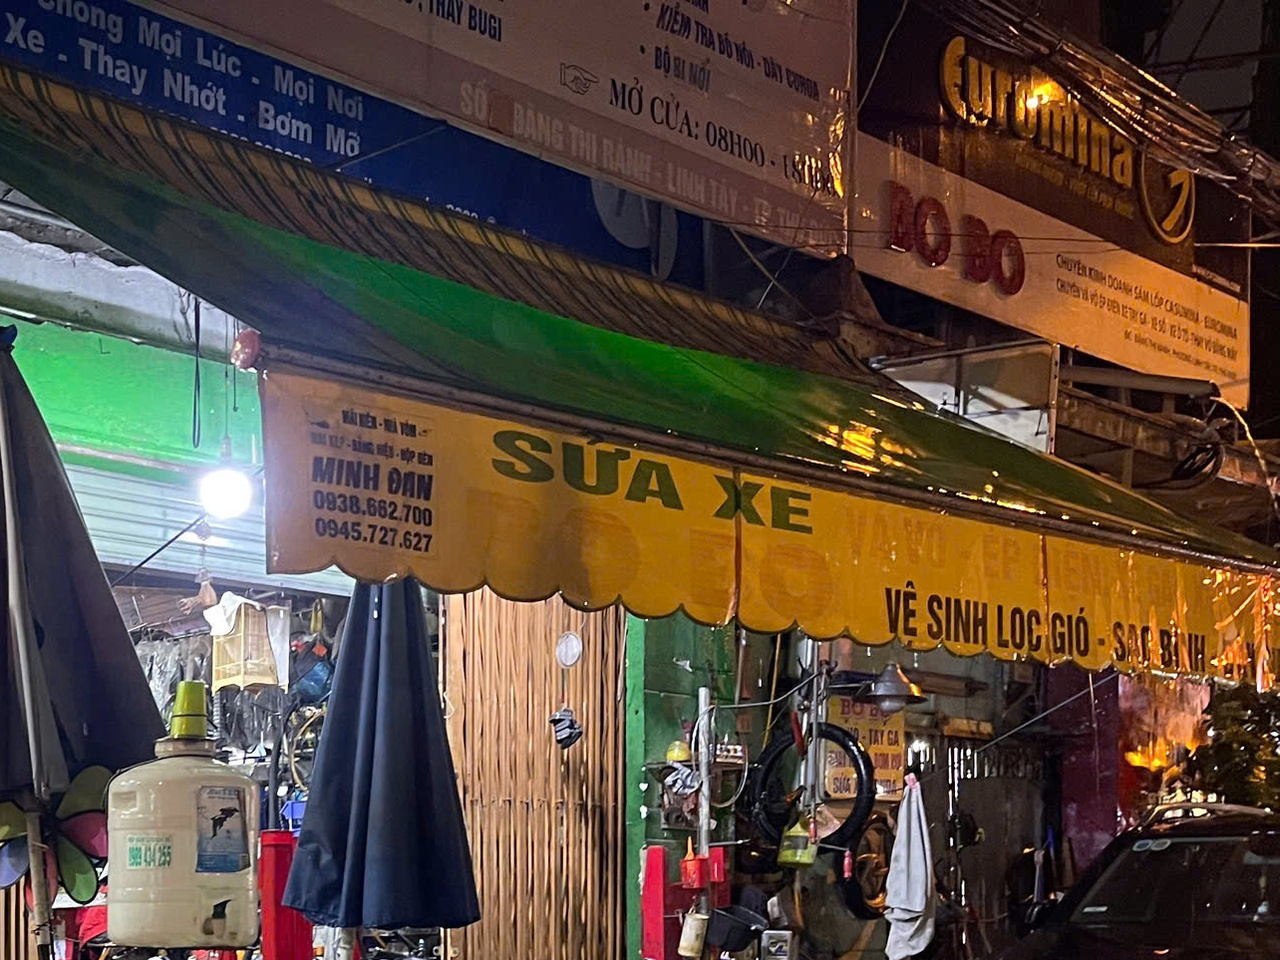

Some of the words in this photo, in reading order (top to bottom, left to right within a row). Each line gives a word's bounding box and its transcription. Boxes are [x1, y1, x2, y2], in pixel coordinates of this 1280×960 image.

[468, 4, 503, 42] BUGI
[4, 12, 46, 54] Xe
[78, 38, 148, 96] Thay
[163, 69, 228, 116] Nhớt
[258, 100, 313, 144] Bơm
[326, 123, 361, 158] Mỡ
[138, 16, 183, 60] Mọi
[197, 37, 242, 78] Lúc
[274, 65, 315, 106] Mọi
[326, 85, 364, 121] Nơi
[609, 77, 644, 116] MỞ
[650, 93, 700, 141] CỬA:
[705, 121, 765, 167] 08H00
[312, 456, 380, 491] MINH
[713, 473, 814, 535] XE
[313, 489, 433, 527] 0938.662.700
[314, 517, 433, 553] 0945.727.627
[927, 594, 988, 645] SINH
[1051, 607, 1089, 657] GIÓ
